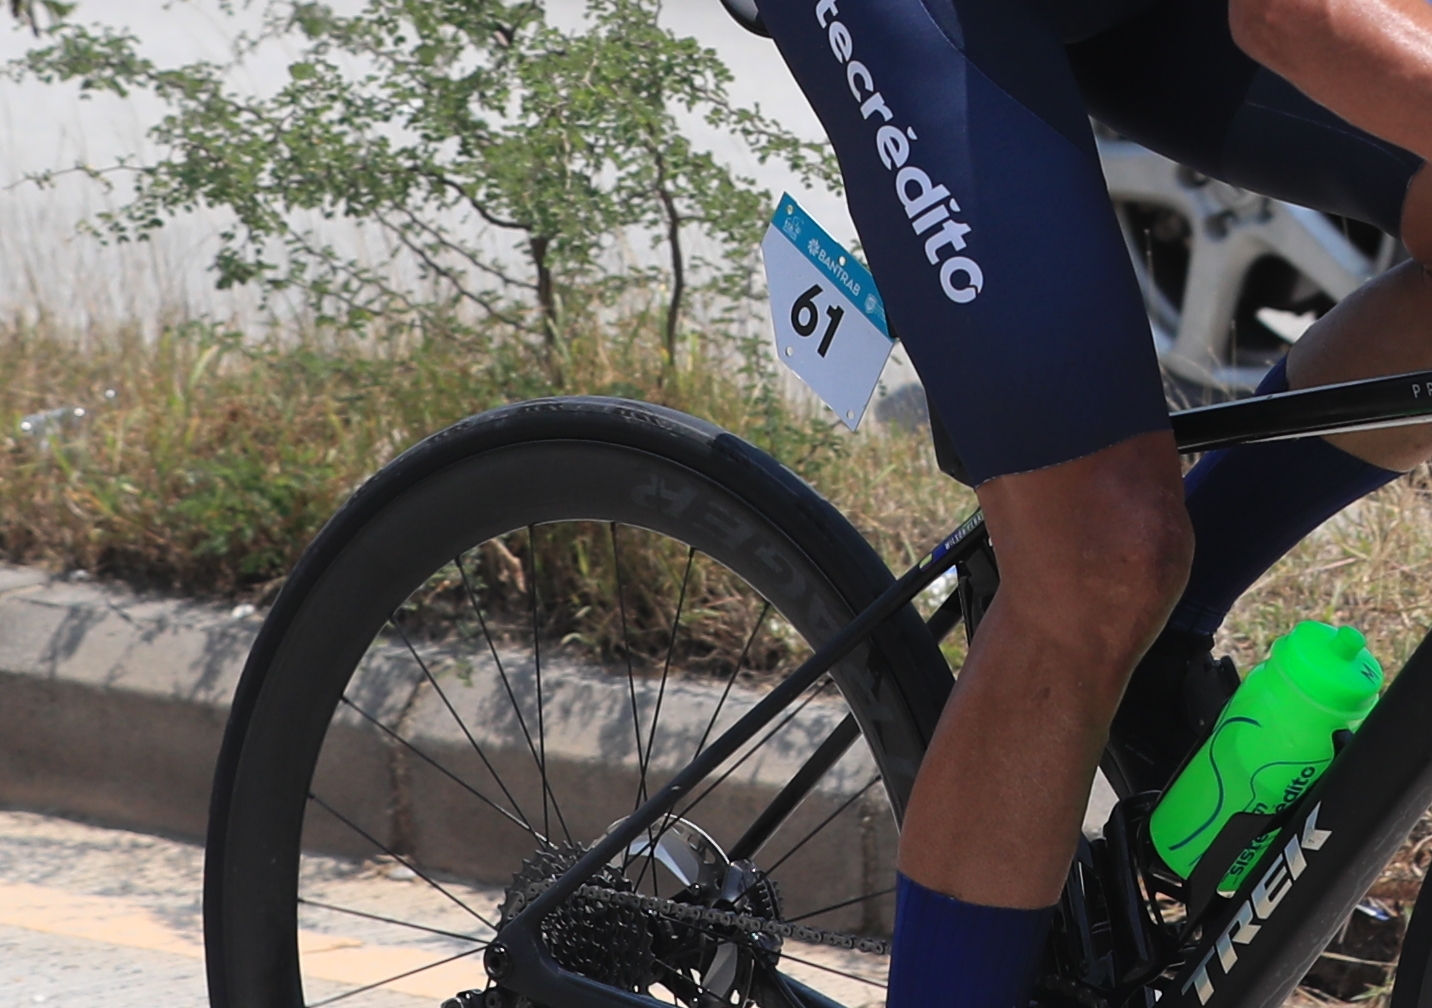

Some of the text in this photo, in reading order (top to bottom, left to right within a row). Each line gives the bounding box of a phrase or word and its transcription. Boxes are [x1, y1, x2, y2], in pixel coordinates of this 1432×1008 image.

[817, 248, 861, 296] BANTRAB
[790, 283, 845, 359] 61
[1181, 800, 1333, 1007] TREK
